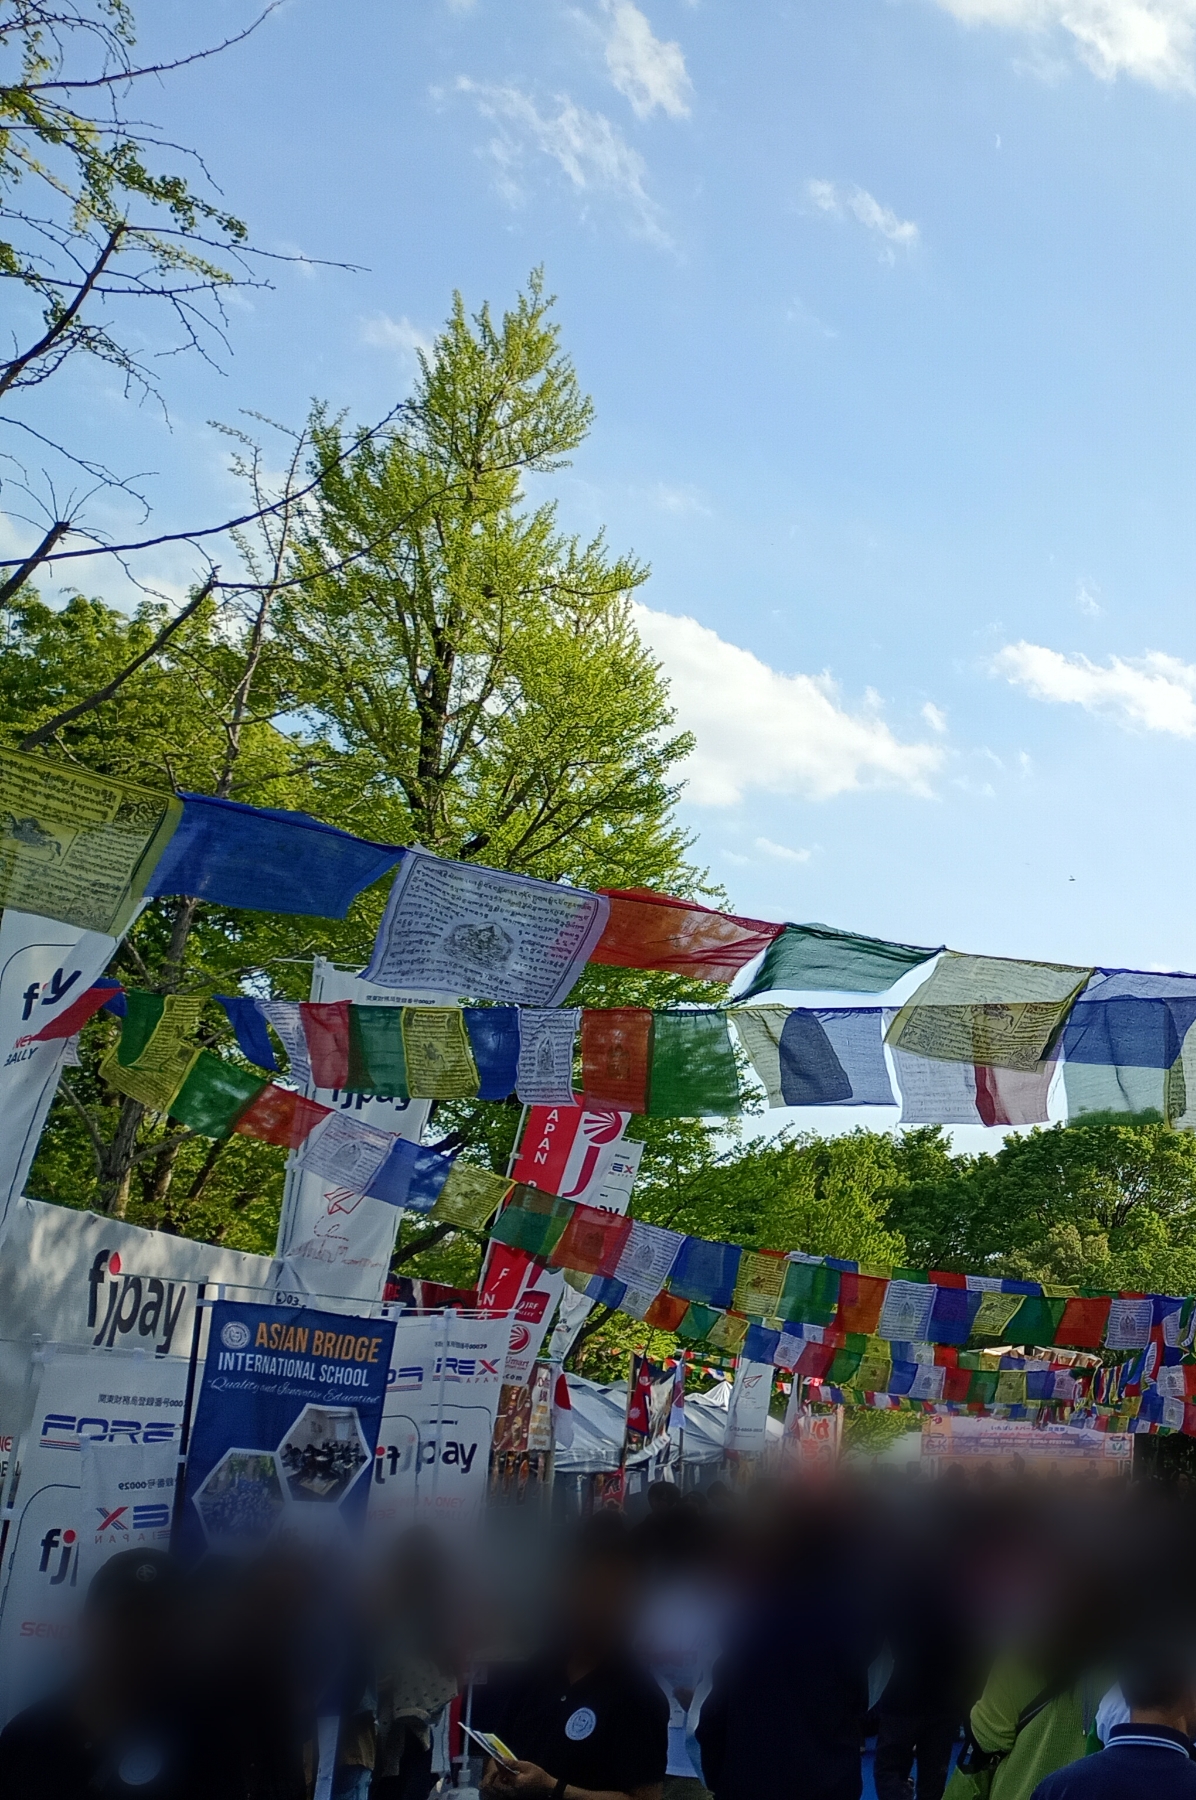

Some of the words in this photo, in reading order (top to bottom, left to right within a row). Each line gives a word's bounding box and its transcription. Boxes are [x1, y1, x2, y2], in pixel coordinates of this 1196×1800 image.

[87, 1249, 186, 1359] fjpay
[255, 1322, 309, 1353] ASIAN
[312, 1330, 383, 1363] BRIDGE
[218, 1352, 316, 1381] INTERNATIONAL
[319, 1364, 370, 1387] SCHOOL
[41, 1413, 178, 1444] FORE
